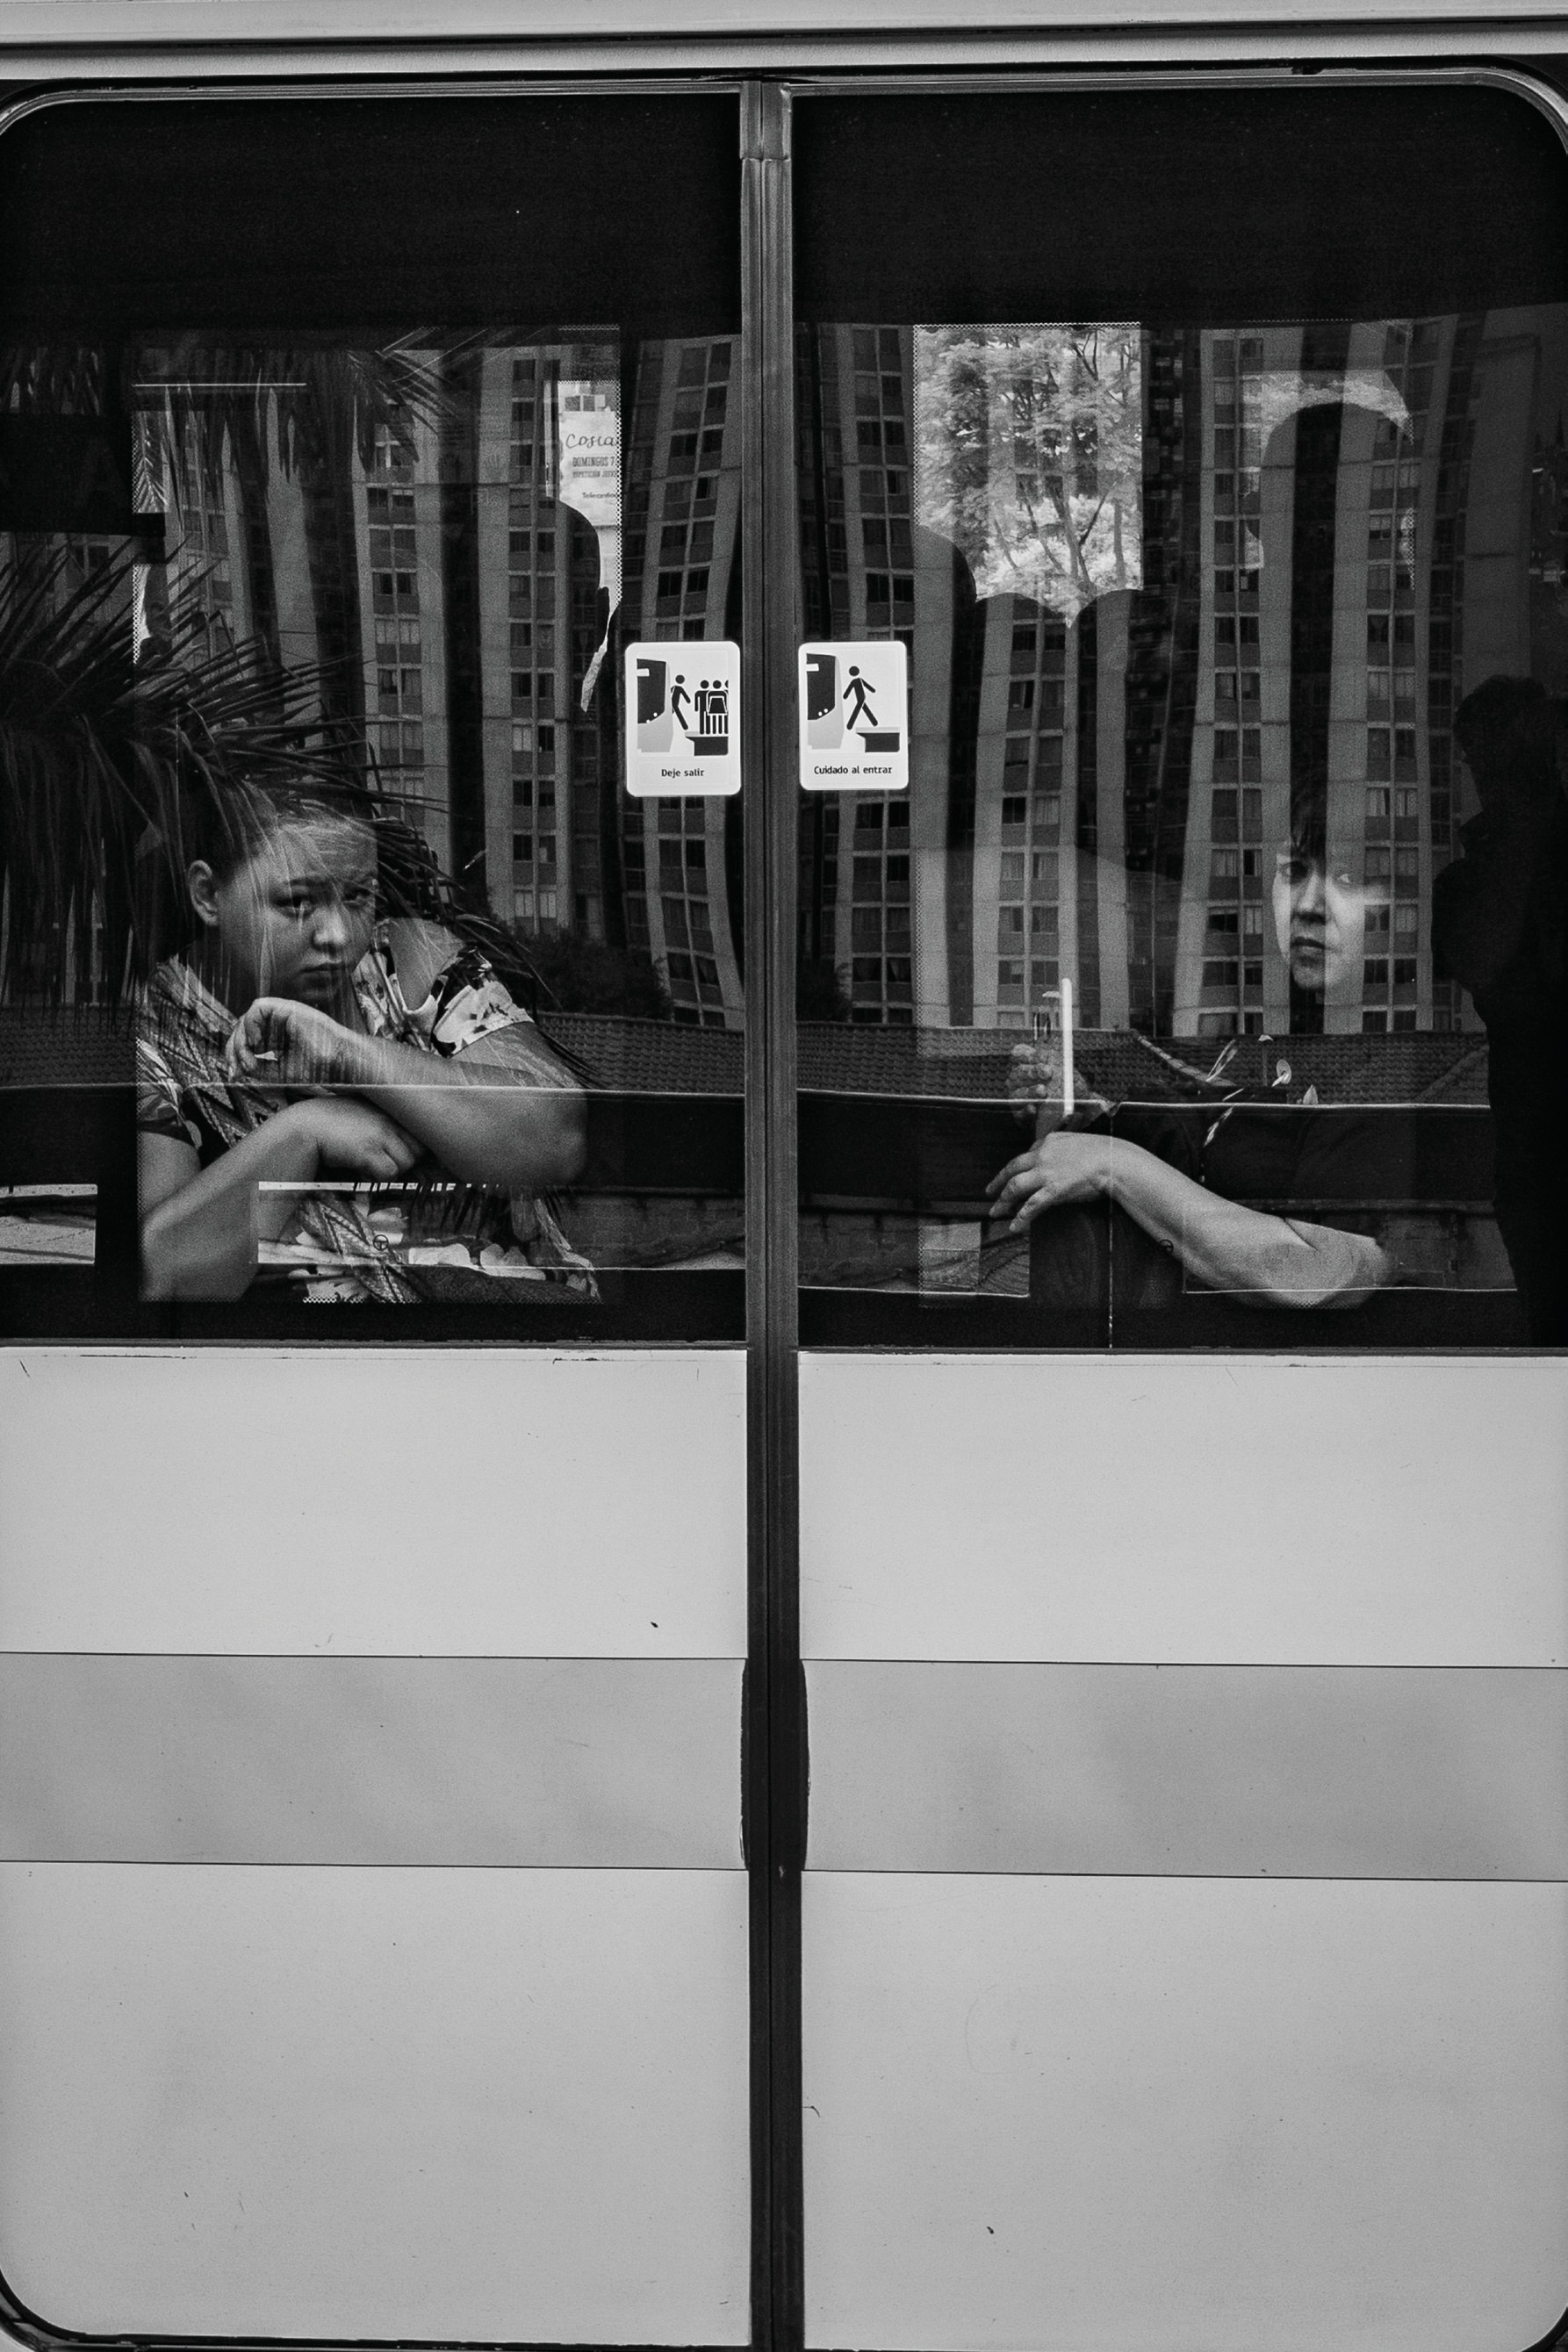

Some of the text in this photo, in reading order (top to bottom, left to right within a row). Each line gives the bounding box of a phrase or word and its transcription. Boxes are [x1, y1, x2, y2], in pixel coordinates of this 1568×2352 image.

[572, 457, 608, 467] DOMINGOS
[661, 767, 704, 779] Deje salir
[814, 765, 892, 774] Cuidado al entrar
